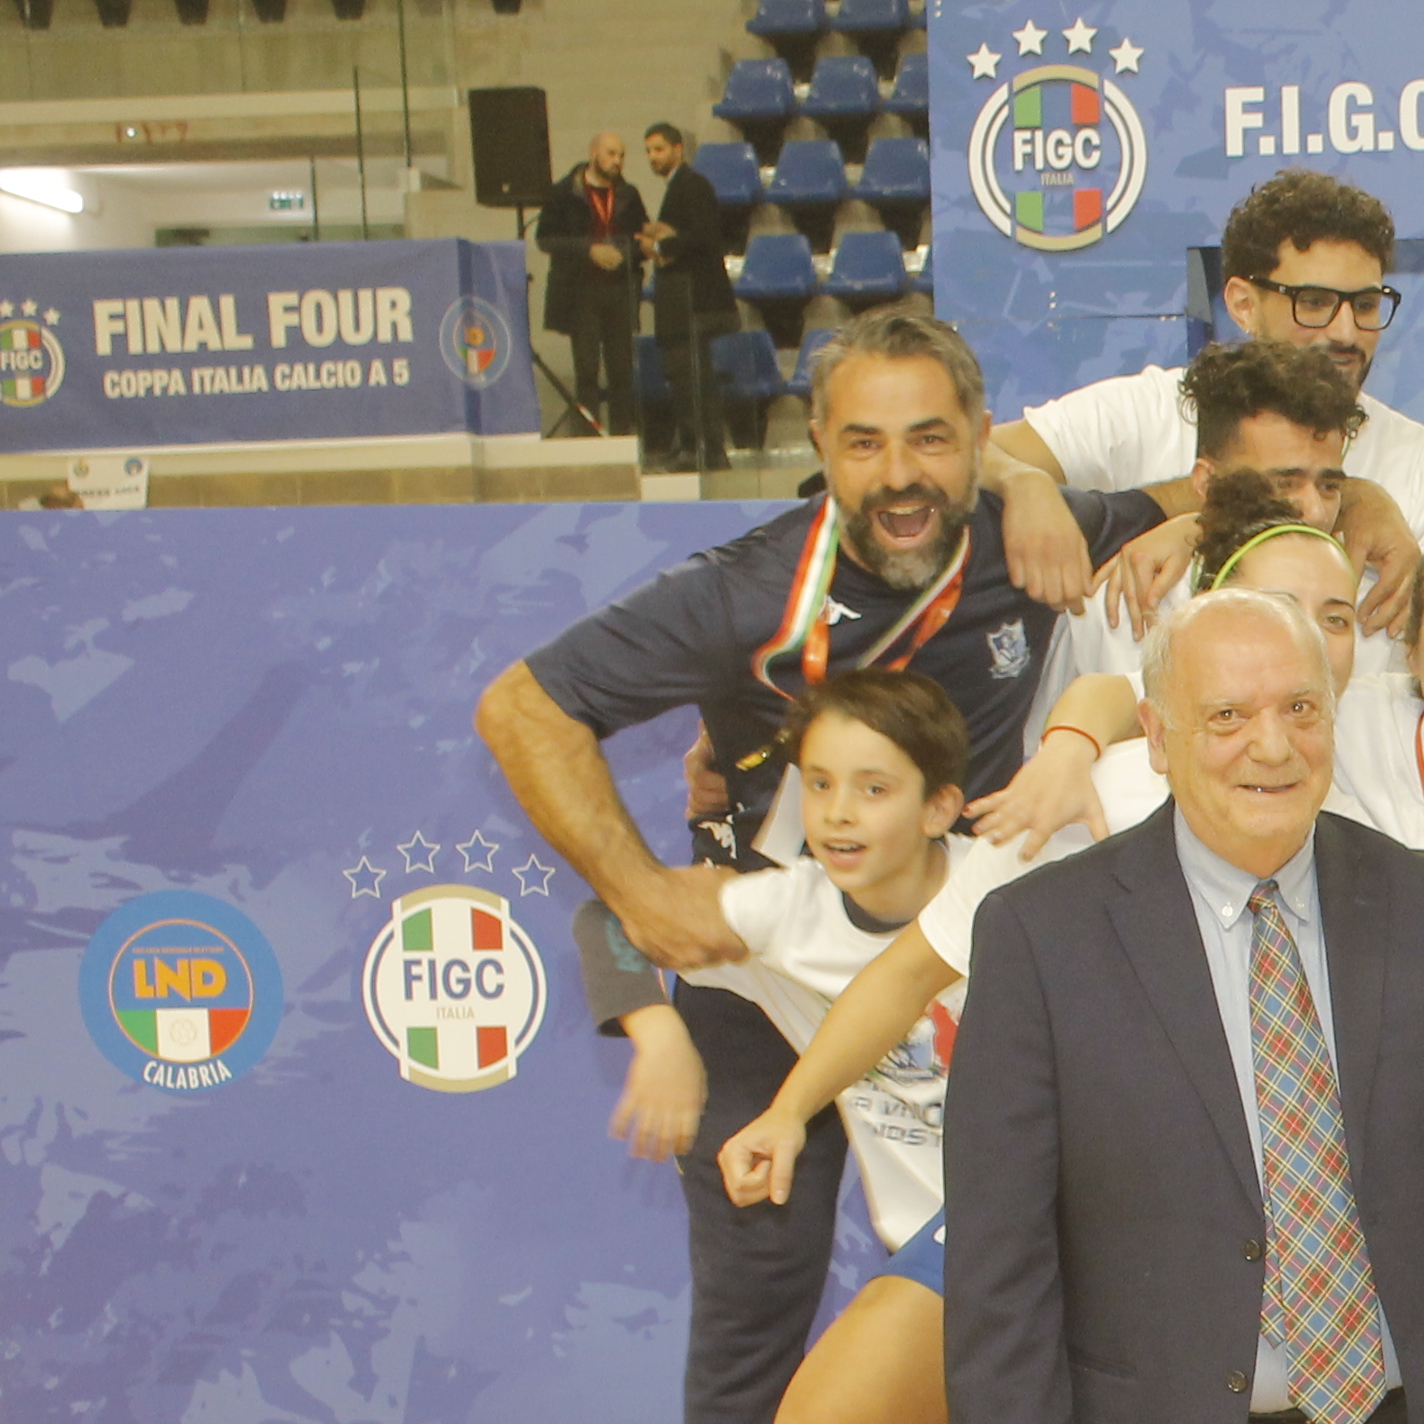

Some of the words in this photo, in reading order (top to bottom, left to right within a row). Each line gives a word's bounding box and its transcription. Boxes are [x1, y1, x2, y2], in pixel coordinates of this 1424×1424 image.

[1013, 127, 1101, 171] FIGC
[1041, 172, 1074, 186] ITALIA
[93, 294, 254, 356] FINAL
[267, 286, 413, 349] FOUR
[103, 368, 187, 399] COPPA
[191, 364, 268, 395] ITALIA
[274, 359, 362, 391] CALCIO
[368, 359, 387, 386] A
[393, 358, 410, 386] 5
[133, 956, 228, 1002] LND
[403, 957, 505, 1002] FIGC
[435, 1005, 475, 1020] ITALIA
[143, 1059, 233, 1089] CALABRIA
